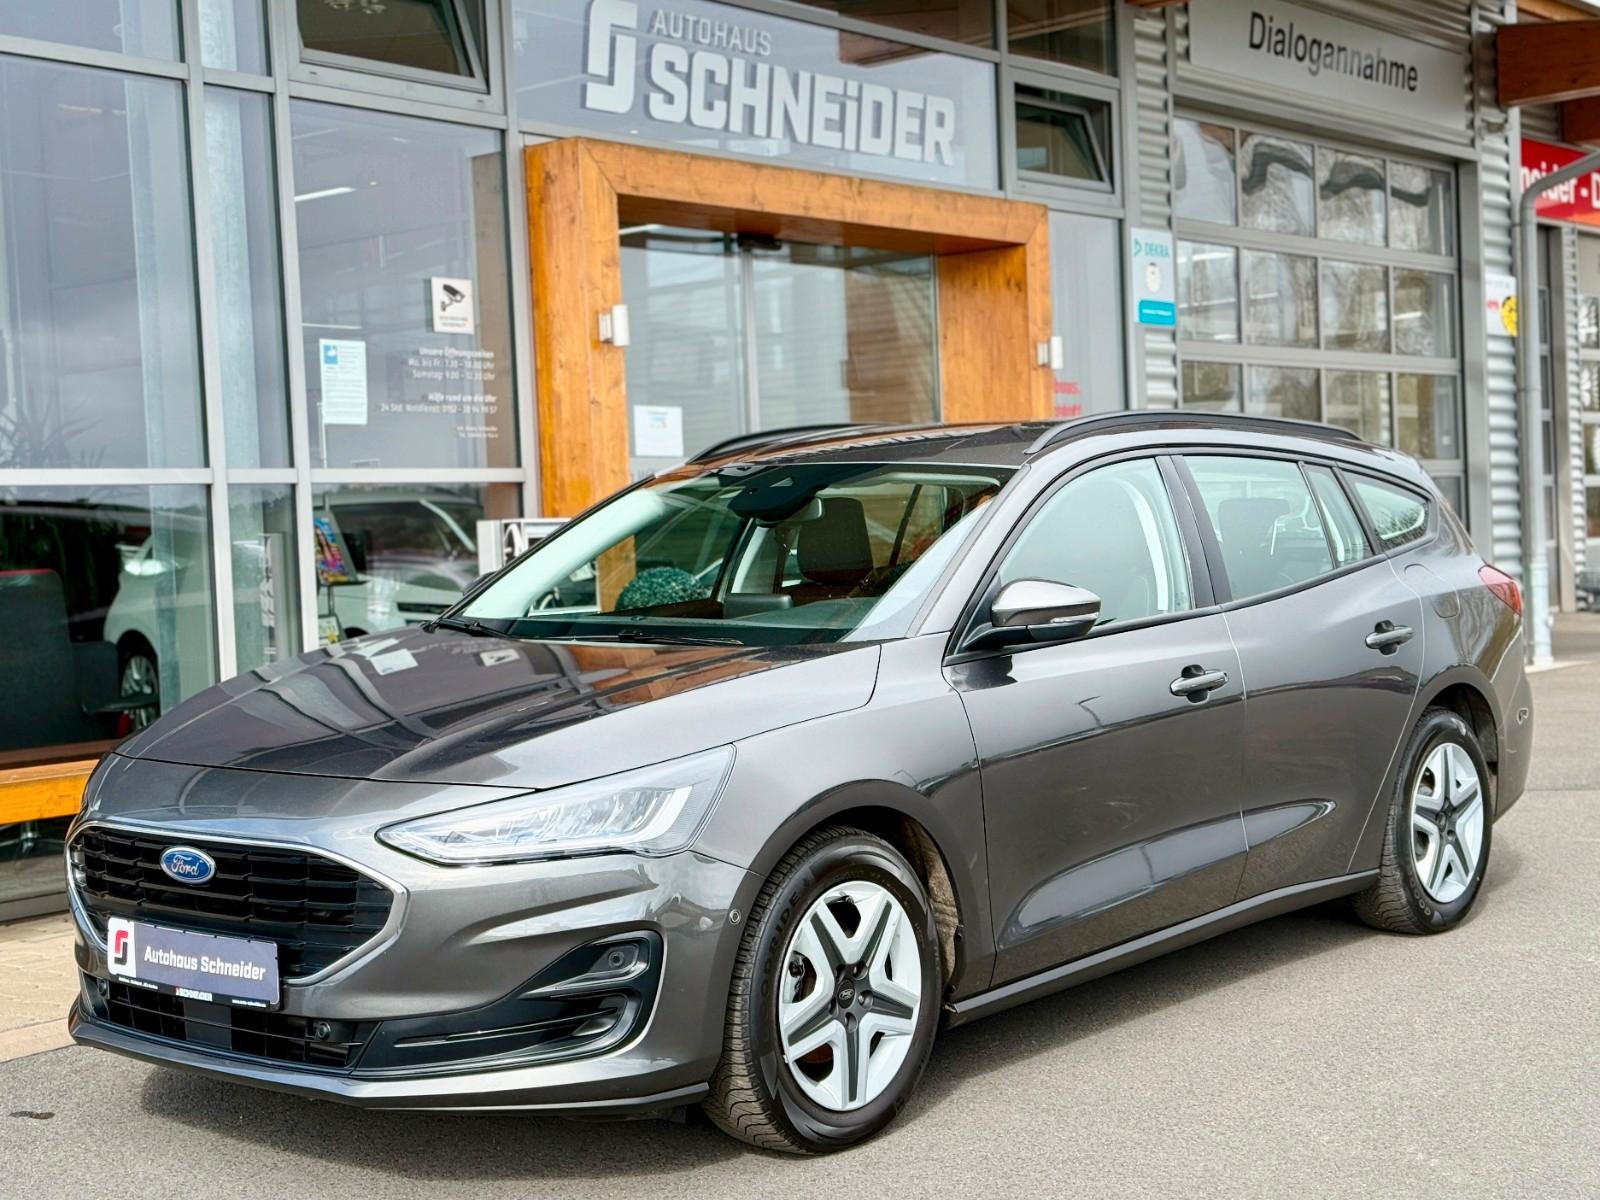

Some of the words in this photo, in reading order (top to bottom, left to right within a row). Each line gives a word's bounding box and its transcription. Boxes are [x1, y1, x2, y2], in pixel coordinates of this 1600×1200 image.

[653, 9, 771, 56] AUTOHAUS
[1249, 12, 1419, 92] Dialogannahme
[171, 854, 200, 876] Ford
[144, 946, 198, 971] Autohaus
[200, 956, 266, 981] Schneider
